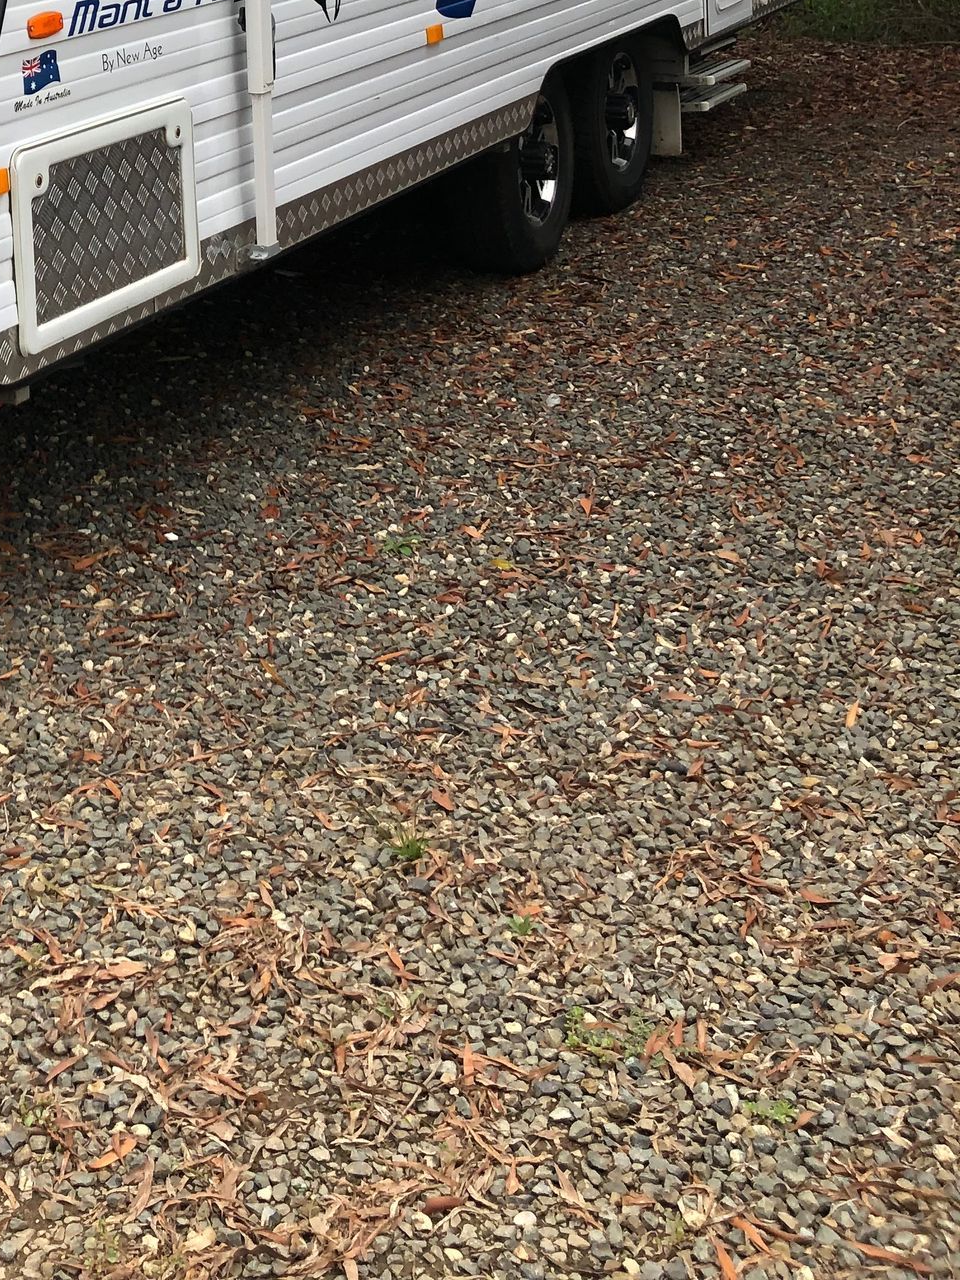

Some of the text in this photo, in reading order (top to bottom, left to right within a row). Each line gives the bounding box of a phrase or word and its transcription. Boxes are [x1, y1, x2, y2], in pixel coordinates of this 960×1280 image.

[101, 41, 163, 74] By New Age
[13, 99, 33, 112] Made
[43, 88, 71, 104] Australia
